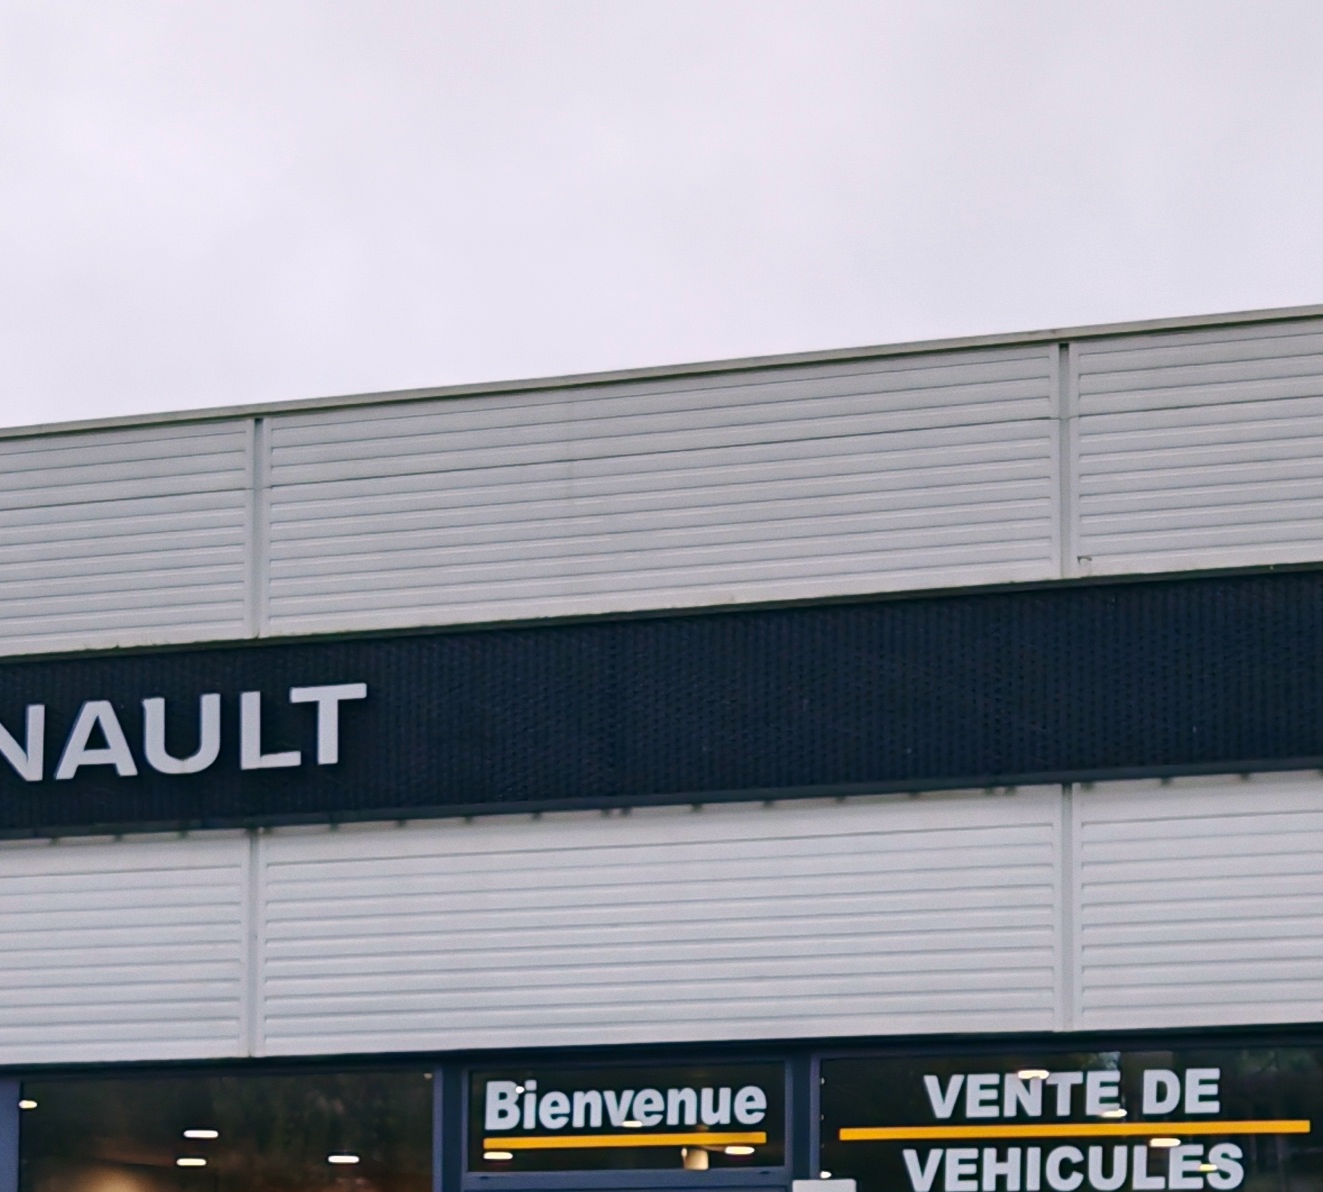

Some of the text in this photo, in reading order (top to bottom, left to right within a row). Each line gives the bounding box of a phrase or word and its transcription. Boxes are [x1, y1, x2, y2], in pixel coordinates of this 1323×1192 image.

[484, 1079, 767, 1131] Bienvenue
[923, 1068, 1221, 1119] VENTE DE
[903, 1142, 1245, 1192] VEHICULES
